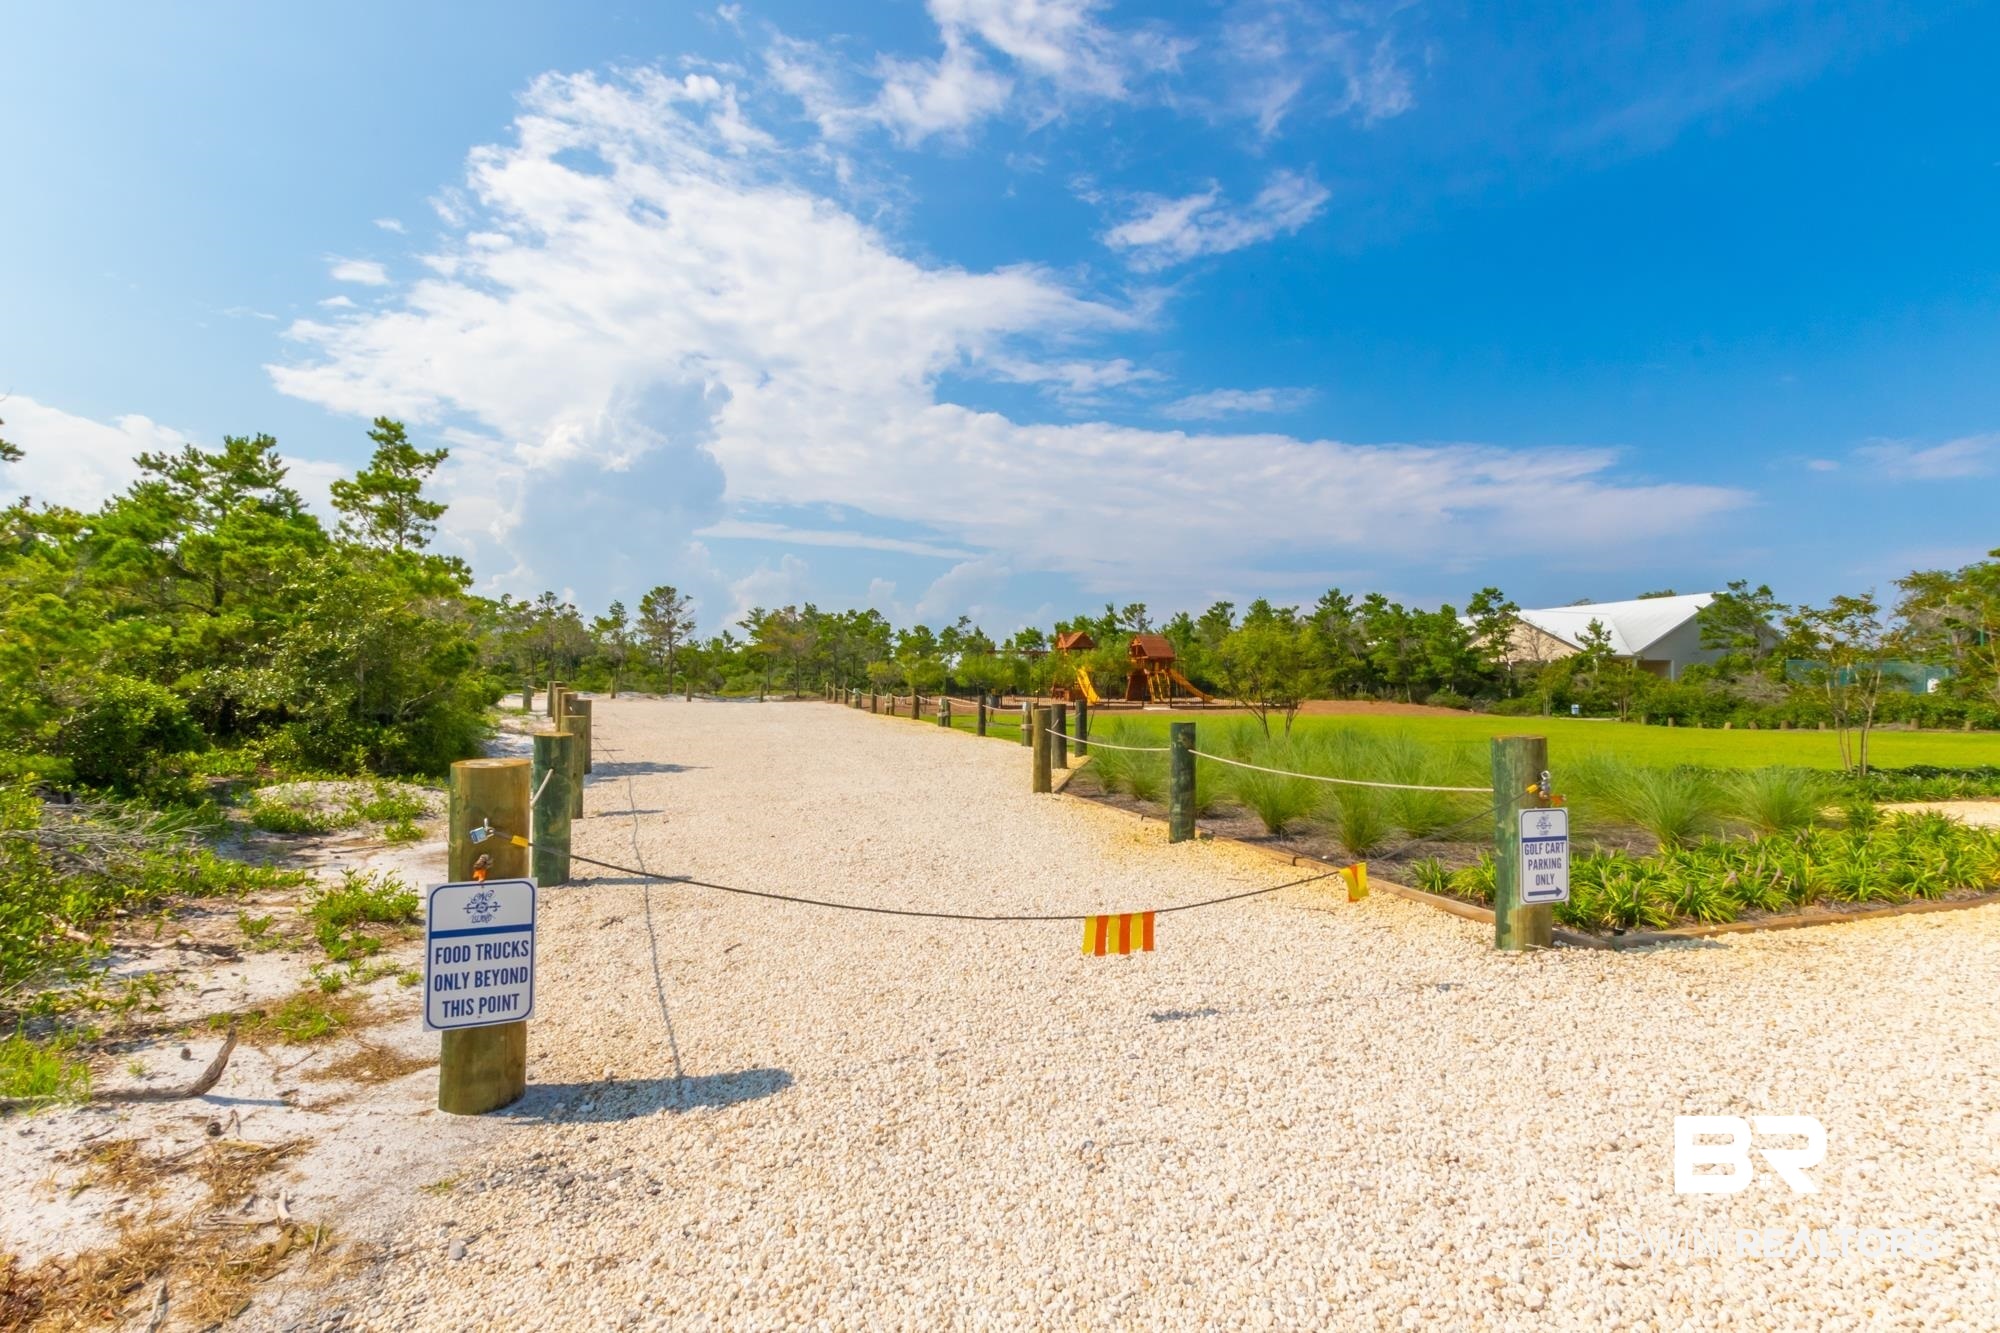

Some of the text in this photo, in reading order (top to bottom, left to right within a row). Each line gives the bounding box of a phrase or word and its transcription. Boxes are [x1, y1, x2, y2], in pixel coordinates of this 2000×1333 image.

[1524, 842, 1565, 856] GOLF CART
[1528, 858, 1562, 870] PARKING
[1535, 874, 1555, 886] ONLY
[435, 940, 529, 965] FOOD TRUCKS
[434, 966, 528, 992] ONLY BEYOND
[442, 993, 520, 1018] THIS POINT
